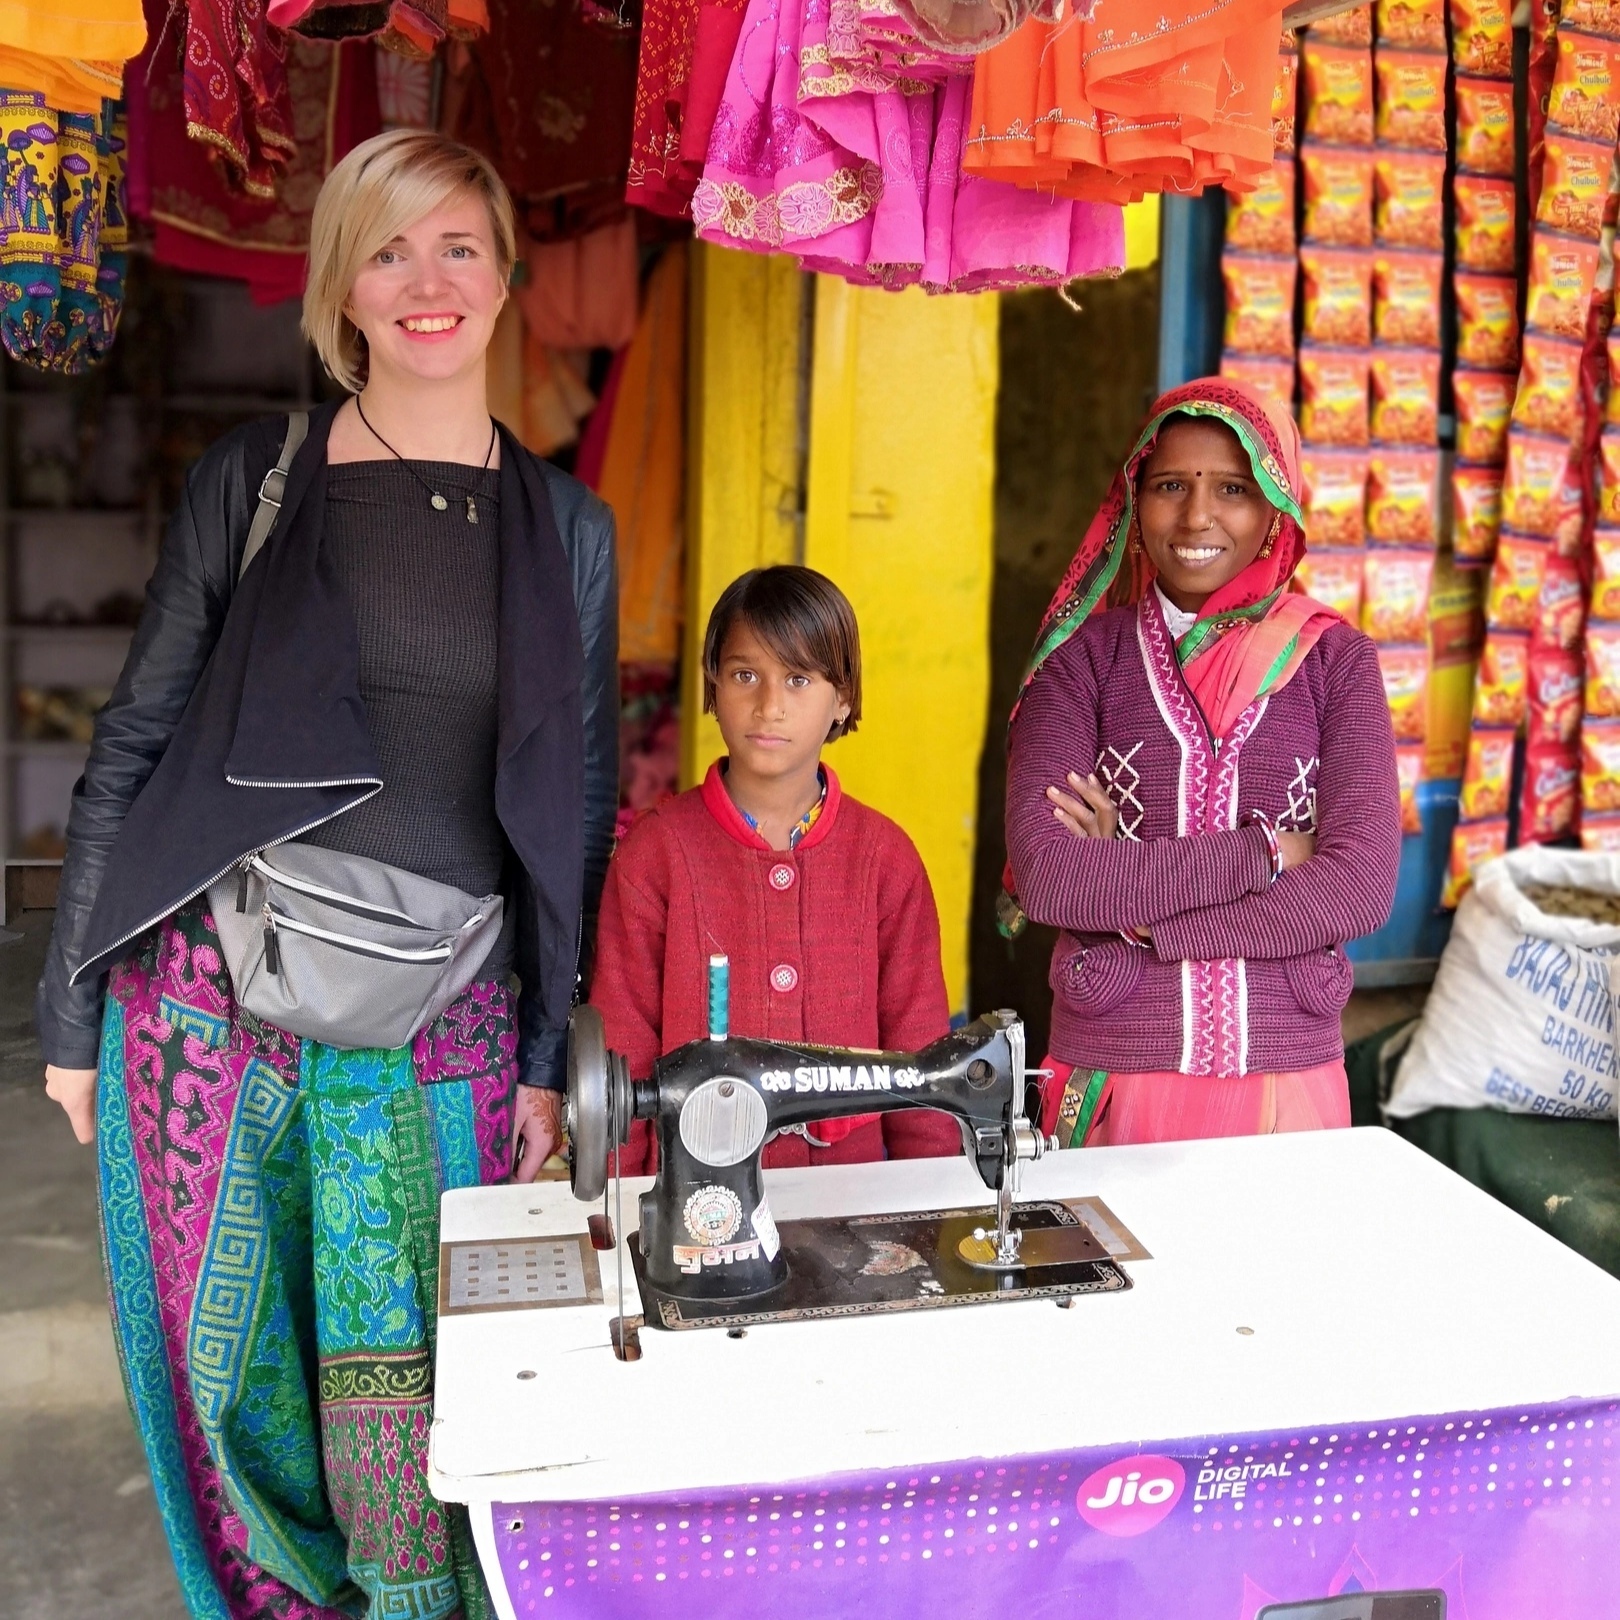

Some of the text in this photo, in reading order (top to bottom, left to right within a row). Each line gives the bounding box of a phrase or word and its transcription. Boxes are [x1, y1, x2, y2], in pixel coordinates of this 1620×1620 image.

[1579, 74, 1612, 85] Chulbule
[1570, 176, 1601, 187] Chulbule
[795, 1065, 892, 1093] SUMAN
[1485, 1066, 1533, 1106] BEST
[1559, 1069, 1586, 1100] 50
[1086, 1462, 1292, 1509] Jio DIGITAL
[1193, 1481, 1248, 1501] LIFE
